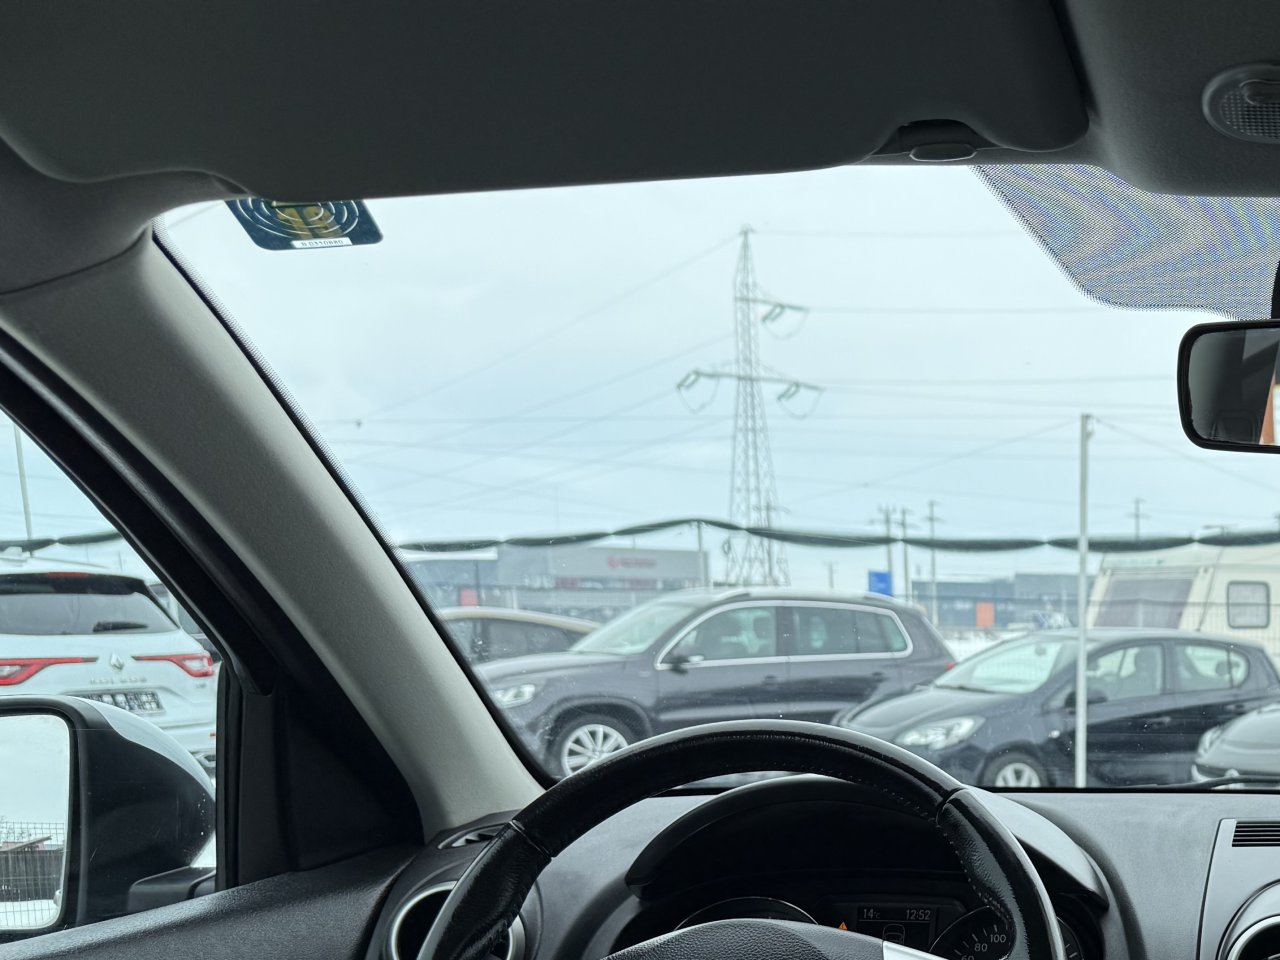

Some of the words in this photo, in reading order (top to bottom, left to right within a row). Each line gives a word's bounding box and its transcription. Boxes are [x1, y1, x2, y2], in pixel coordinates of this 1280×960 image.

[905, 909, 931, 921] 12:52
[990, 934, 1007, 943] 100
[974, 943, 988, 952] 80
